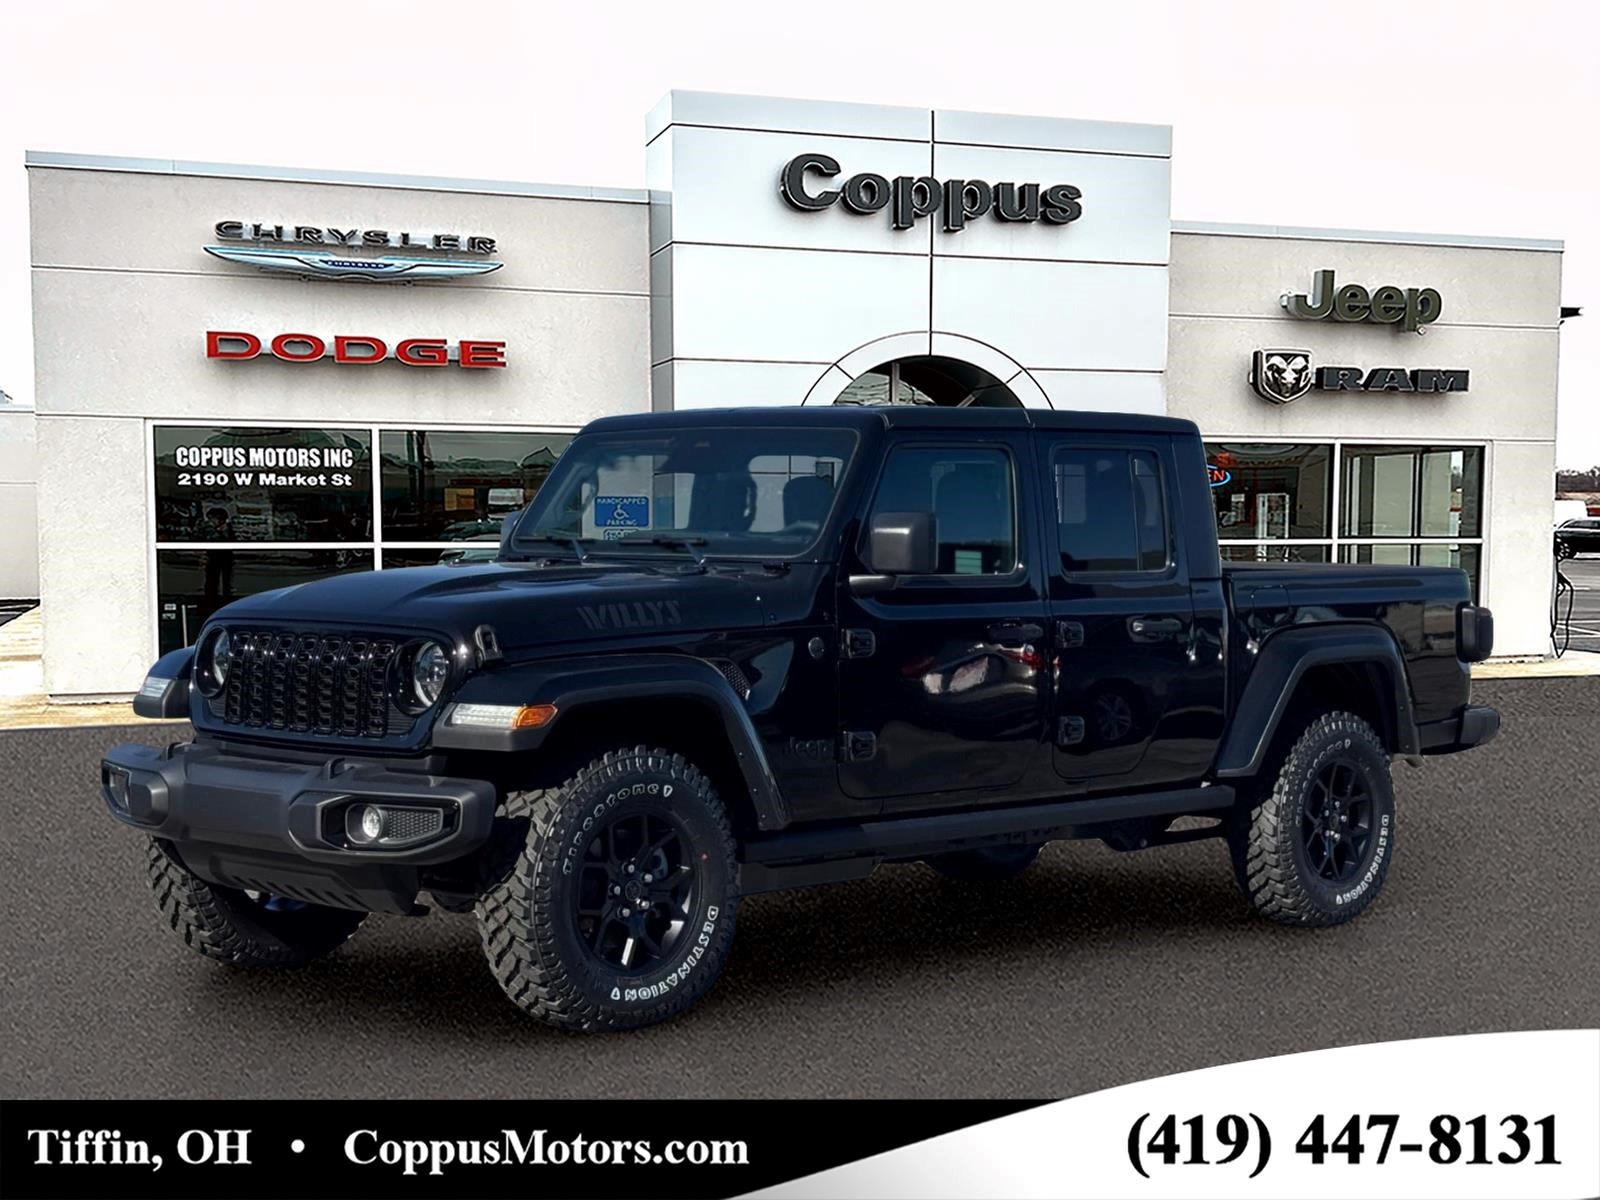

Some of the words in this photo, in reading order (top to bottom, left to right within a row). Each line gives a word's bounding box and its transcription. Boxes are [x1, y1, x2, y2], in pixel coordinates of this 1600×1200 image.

[780, 152, 1083, 232] Coppus
[214, 220, 498, 253] CHRYSLER
[1284, 270, 1442, 332] Jeep
[206, 331, 507, 368] DODGE
[1315, 366, 1471, 392] RAM
[176, 446, 246, 467] COPPUS
[249, 447, 321, 468] MOTORS
[323, 448, 353, 467] INC
[177, 473, 229, 486] 2190
[233, 473, 253, 486] W
[258, 473, 327, 486] Market
[331, 473, 352, 486] St
[576, 600, 682, 631] WILLYS
[624, 905, 719, 1001] DESTINATION
